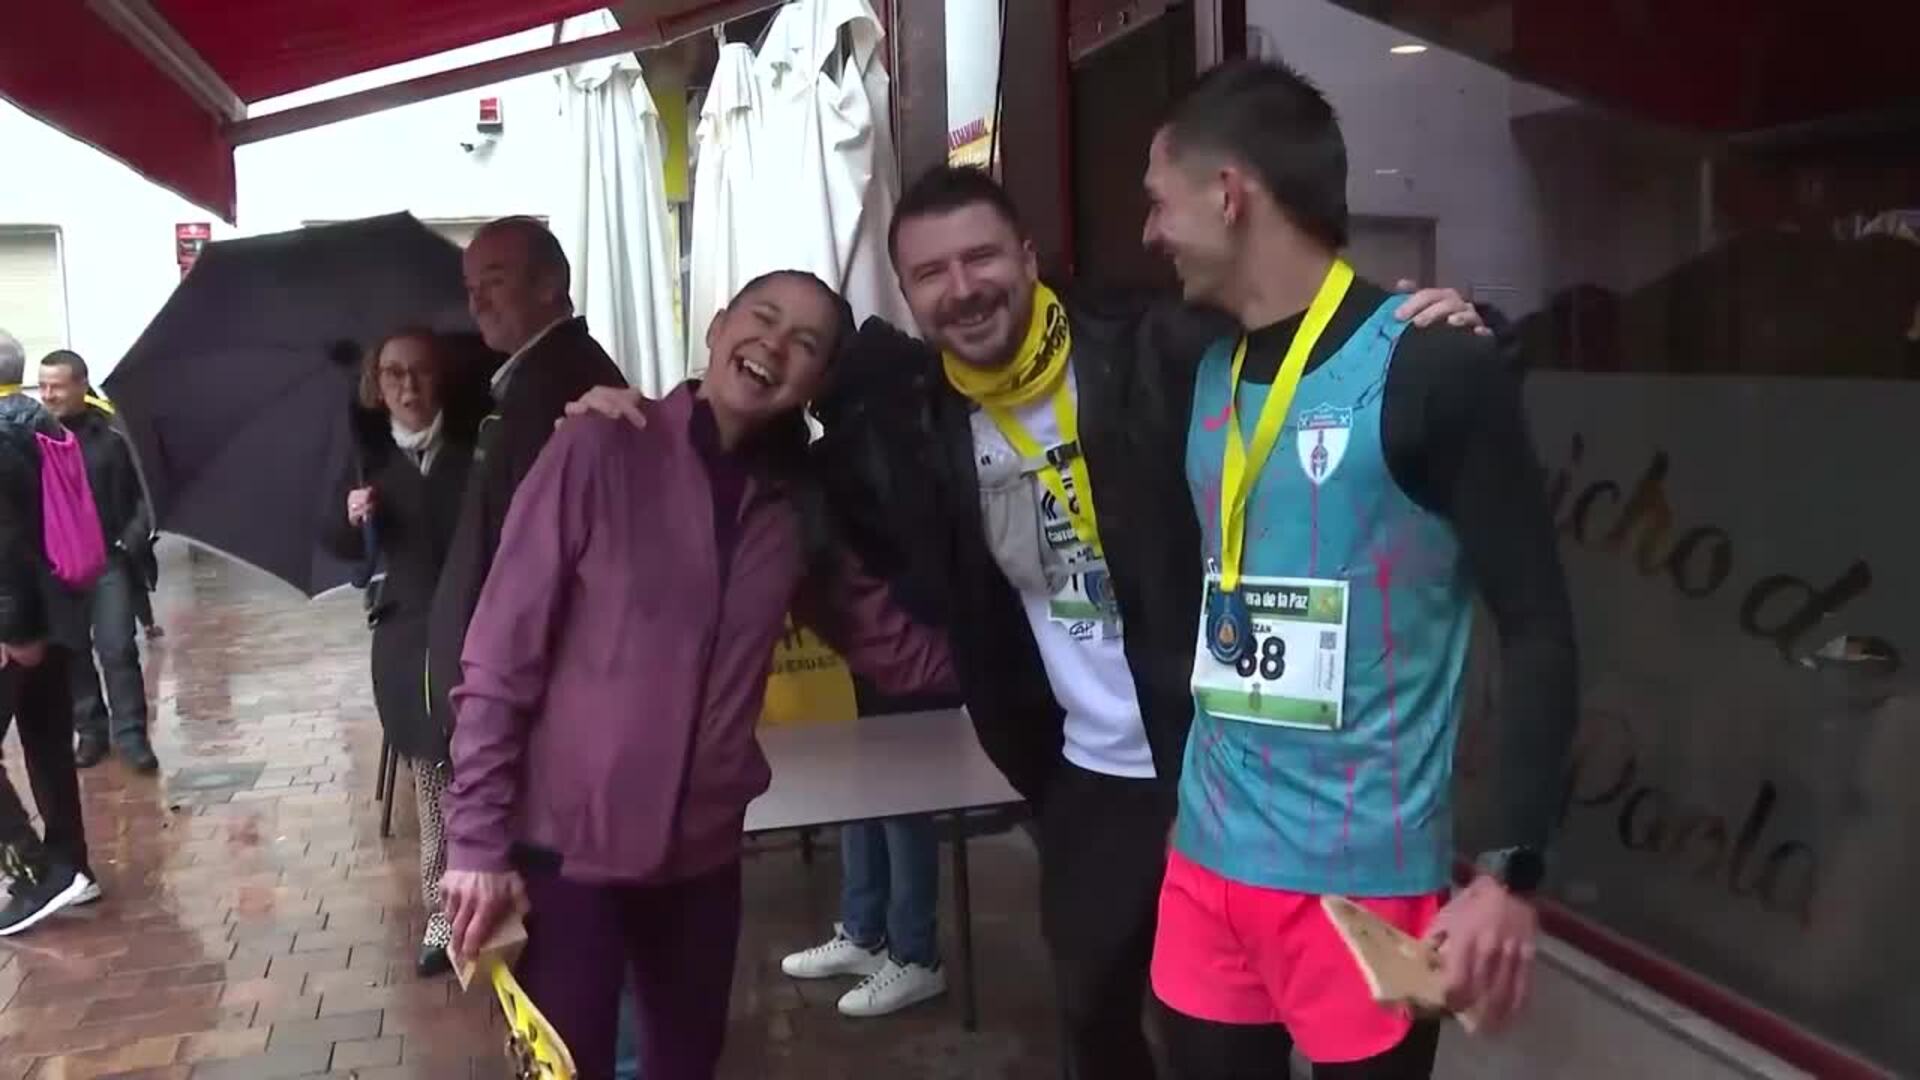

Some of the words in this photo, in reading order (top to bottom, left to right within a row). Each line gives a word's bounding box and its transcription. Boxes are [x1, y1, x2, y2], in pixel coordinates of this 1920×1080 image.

[1262, 592, 1276, 608] de
[1277, 592, 1288, 608] la
[1289, 592, 1309, 610] Paz
[1250, 624, 1272, 634] ZAN
